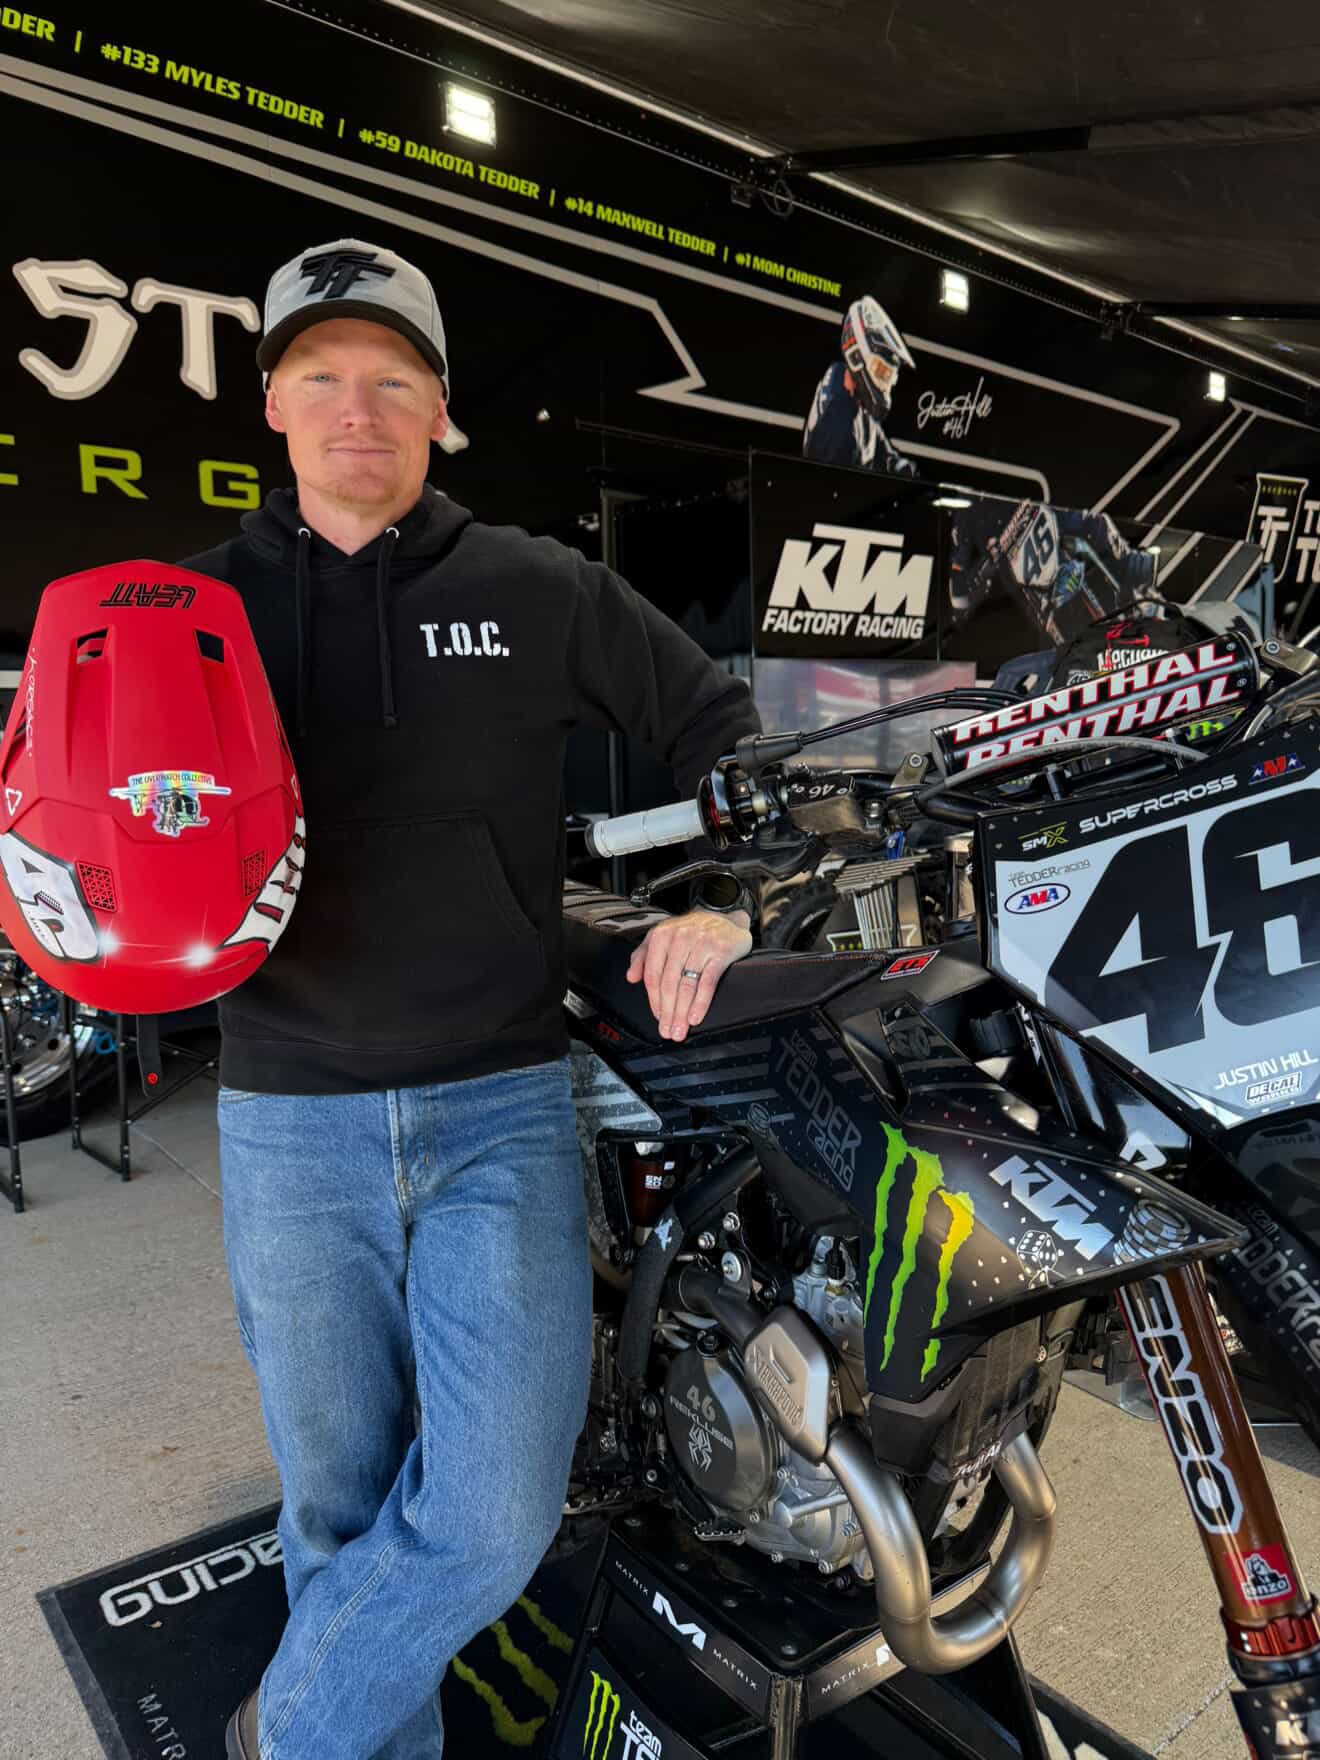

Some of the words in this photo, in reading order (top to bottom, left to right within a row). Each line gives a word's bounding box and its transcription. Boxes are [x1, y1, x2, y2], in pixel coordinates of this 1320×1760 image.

[0, 6, 55, 42] DER
[101, 43, 160, 74] #133
[164, 60, 241, 100] MYLES
[246, 86, 324, 129] TEDDER
[359, 128, 401, 153] #59
[404, 140, 473, 179] DAKOTA
[479, 164, 540, 200] TEDDER
[564, 195, 594, 217] #14
[595, 204, 665, 241] MAXWELL
[668, 225, 716, 257] TEDDER
[752, 255, 785, 280] MOM
[786, 265, 842, 298] CHRISTINE
[768, 523, 935, 616] KTM
[99, 582, 197, 609] LEATT
[419, 620, 510, 657] T.O.C.
[762, 610, 852, 638] FACTORY
[854, 616, 926, 640] RACING
[953, 643, 1236, 744] RENTHAL
[963, 676, 1244, 770] RENTHAL
[1079, 773, 1239, 834] SUPERCROSS
[1017, 887, 1061, 910] AMA
[1045, 788, 1320, 1054] 46
[1215, 1057, 1279, 1090] JUSTIN
[1280, 1048, 1319, 1072] HILL
[988, 1155, 1114, 1261] KTM
[686, 1384, 716, 1423] 46
[615, 1560, 649, 1597] MATRIX
[713, 1647, 758, 1691] MATRIX
[821, 1663, 870, 1695] MATRIX
[629, 1709, 662, 1757] team
